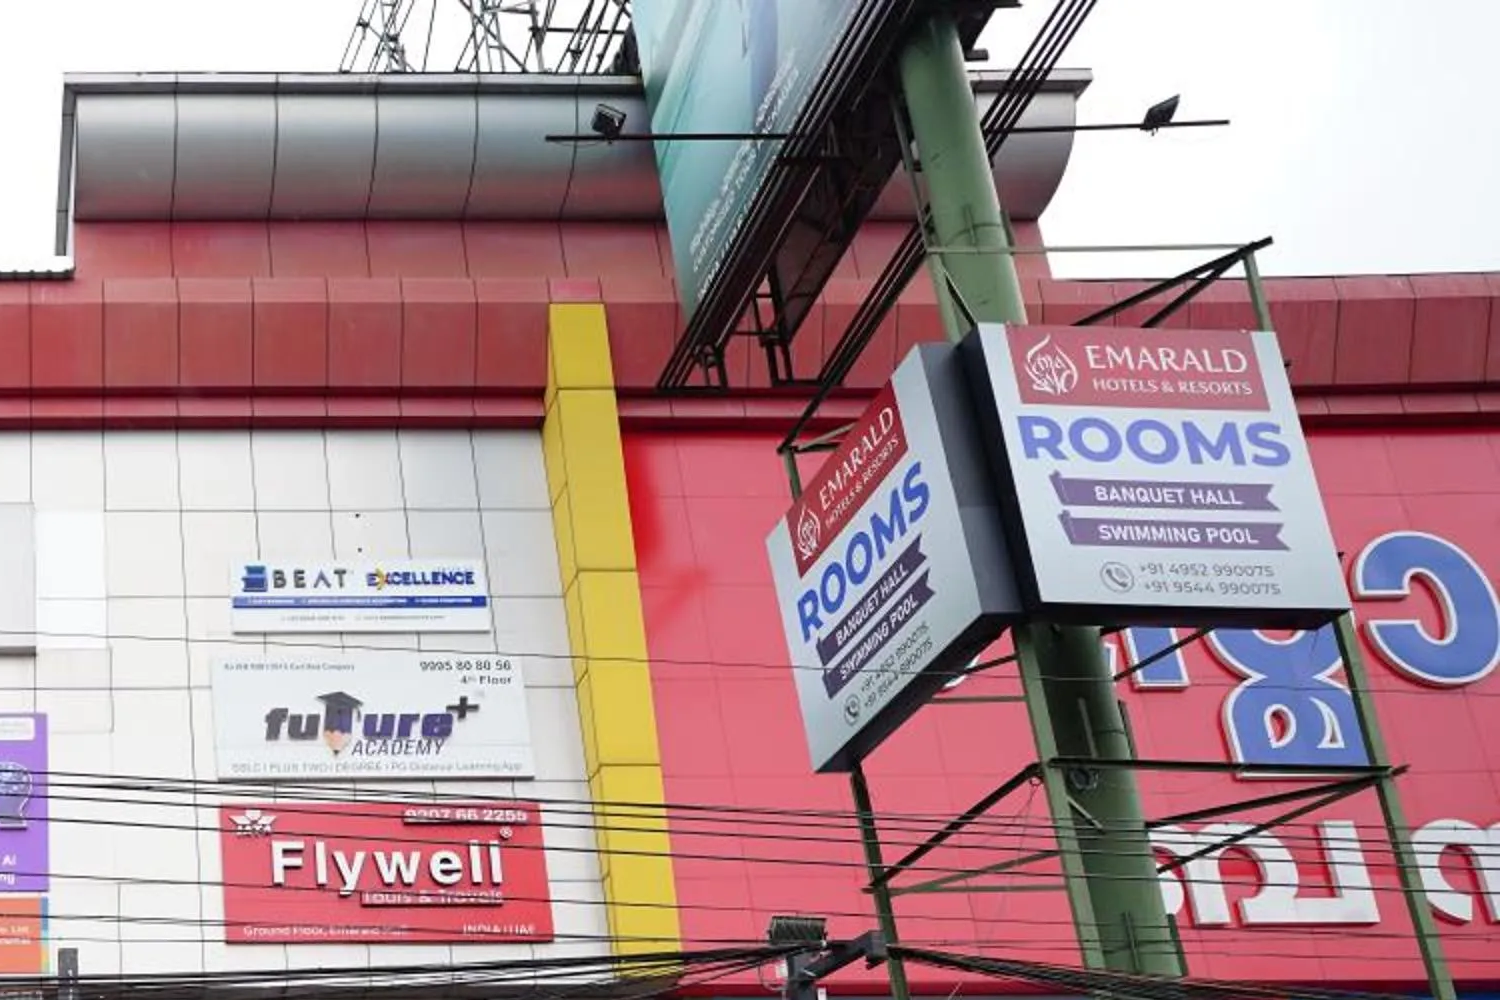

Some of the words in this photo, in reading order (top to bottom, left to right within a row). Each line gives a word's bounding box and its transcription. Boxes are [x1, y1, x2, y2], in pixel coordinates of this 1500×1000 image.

[1085, 345, 1247, 373] EMARALD
[1094, 378, 1155, 394] HOTELS
[1162, 380, 1174, 393] &
[1179, 380, 1253, 396] RESORTS
[818, 406, 894, 508] EMARALD
[1017, 415, 1291, 467] ROOMS
[861, 436, 901, 491] RESORTS
[1095, 485, 1186, 504] BANQUET
[1190, 488, 1243, 505] HALL
[797, 461, 931, 643] ROOMS
[1098, 525, 1200, 543] SWIMMING
[1207, 527, 1259, 544] POOL
[273, 569, 348, 588] BEAT
[366, 569, 475, 591] EXCELLENCE
[1168, 564, 1208, 576] 4952
[1212, 565, 1275, 577] 990075
[835, 588, 880, 646] BANQUET
[878, 564, 908, 605] HALL
[839, 622, 890, 682] SWIMMING
[889, 596, 919, 632] POOL
[352, 738, 445, 757] ACADEMY
[271, 840, 504, 897] Flywell
